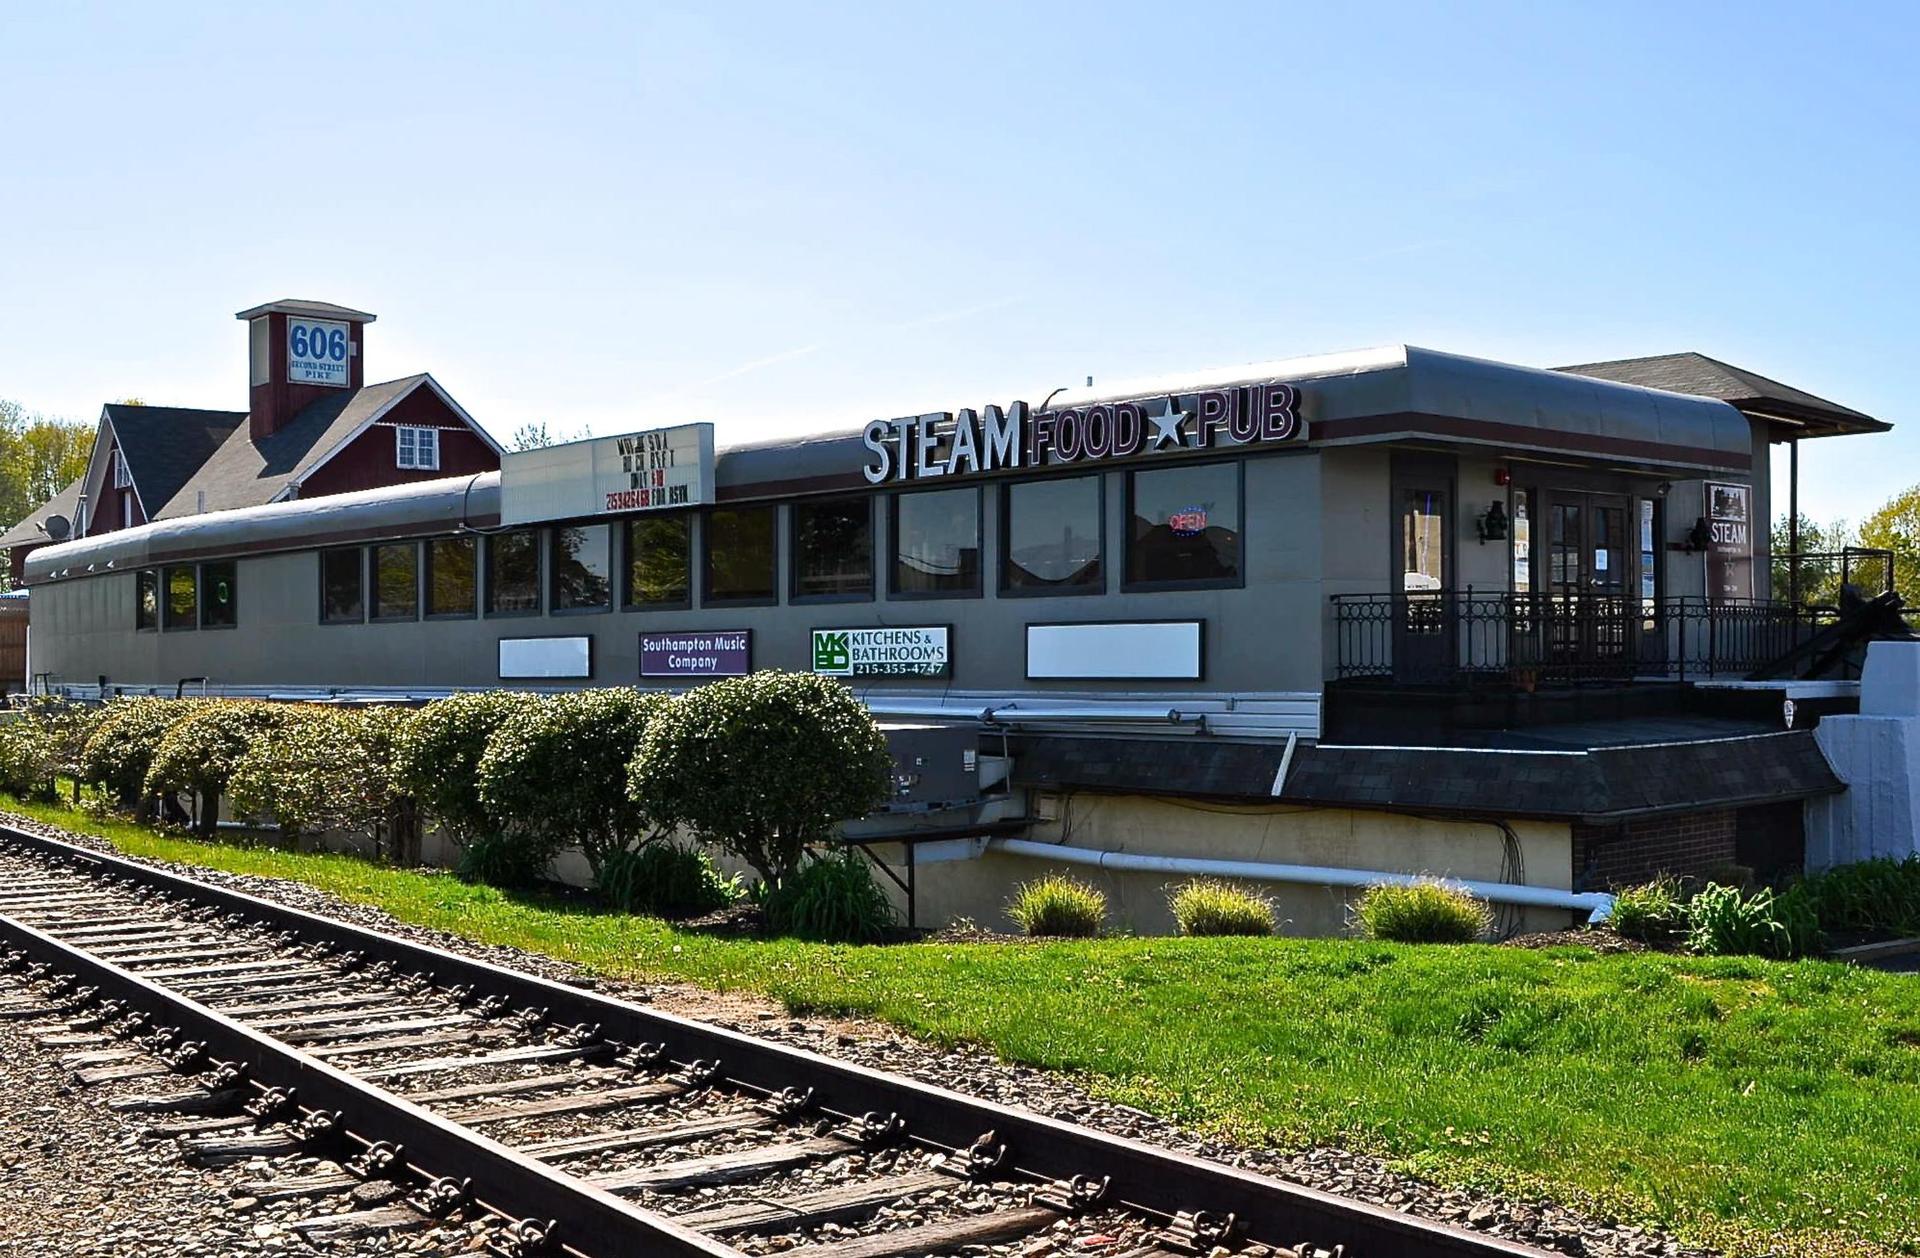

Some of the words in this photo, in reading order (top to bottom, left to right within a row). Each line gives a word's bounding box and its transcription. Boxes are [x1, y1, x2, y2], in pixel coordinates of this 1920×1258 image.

[291, 325, 345, 361] 606
[863, 400, 1027, 484] STEAM
[1031, 402, 1147, 465] FOOD
[1197, 384, 1300, 447] PUB
[1711, 522, 1746, 544] STEAM
[643, 637, 712, 654] Southampton
[714, 635, 746, 651] Music
[852, 630, 921, 646] KITCHENS
[923, 634, 932, 644] &
[852, 646, 944, 661] BATHROOMS
[668, 655, 717, 671] Company
[856, 663, 944, 674] 215-355-4747
